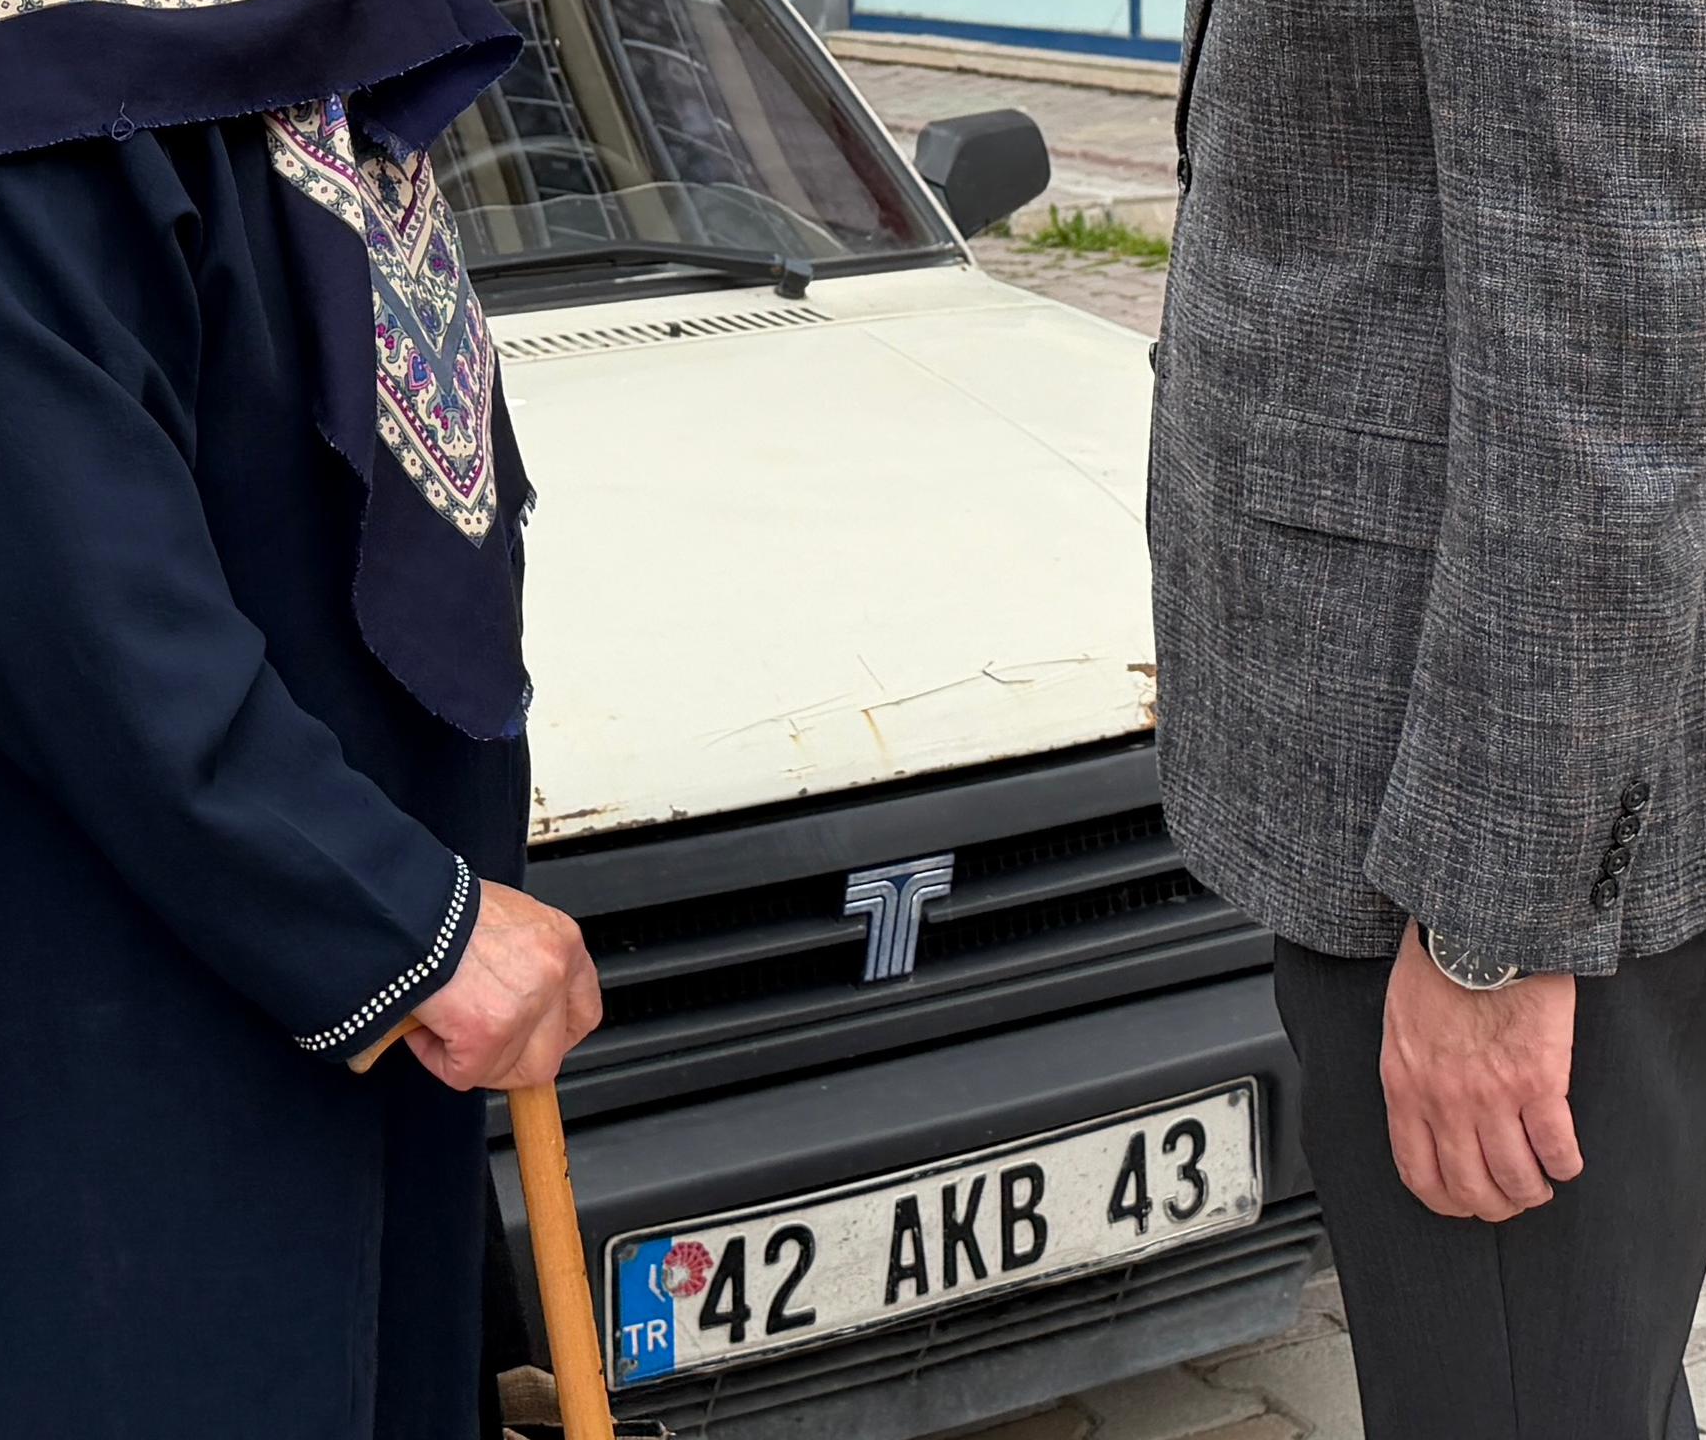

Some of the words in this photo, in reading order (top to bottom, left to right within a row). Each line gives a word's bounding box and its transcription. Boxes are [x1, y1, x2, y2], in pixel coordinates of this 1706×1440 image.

[698, 1224, 817, 1344] 42
[883, 1161, 1049, 1307] AKB
[1107, 1115, 1210, 1237] 43
[623, 1319, 668, 1357] TR
